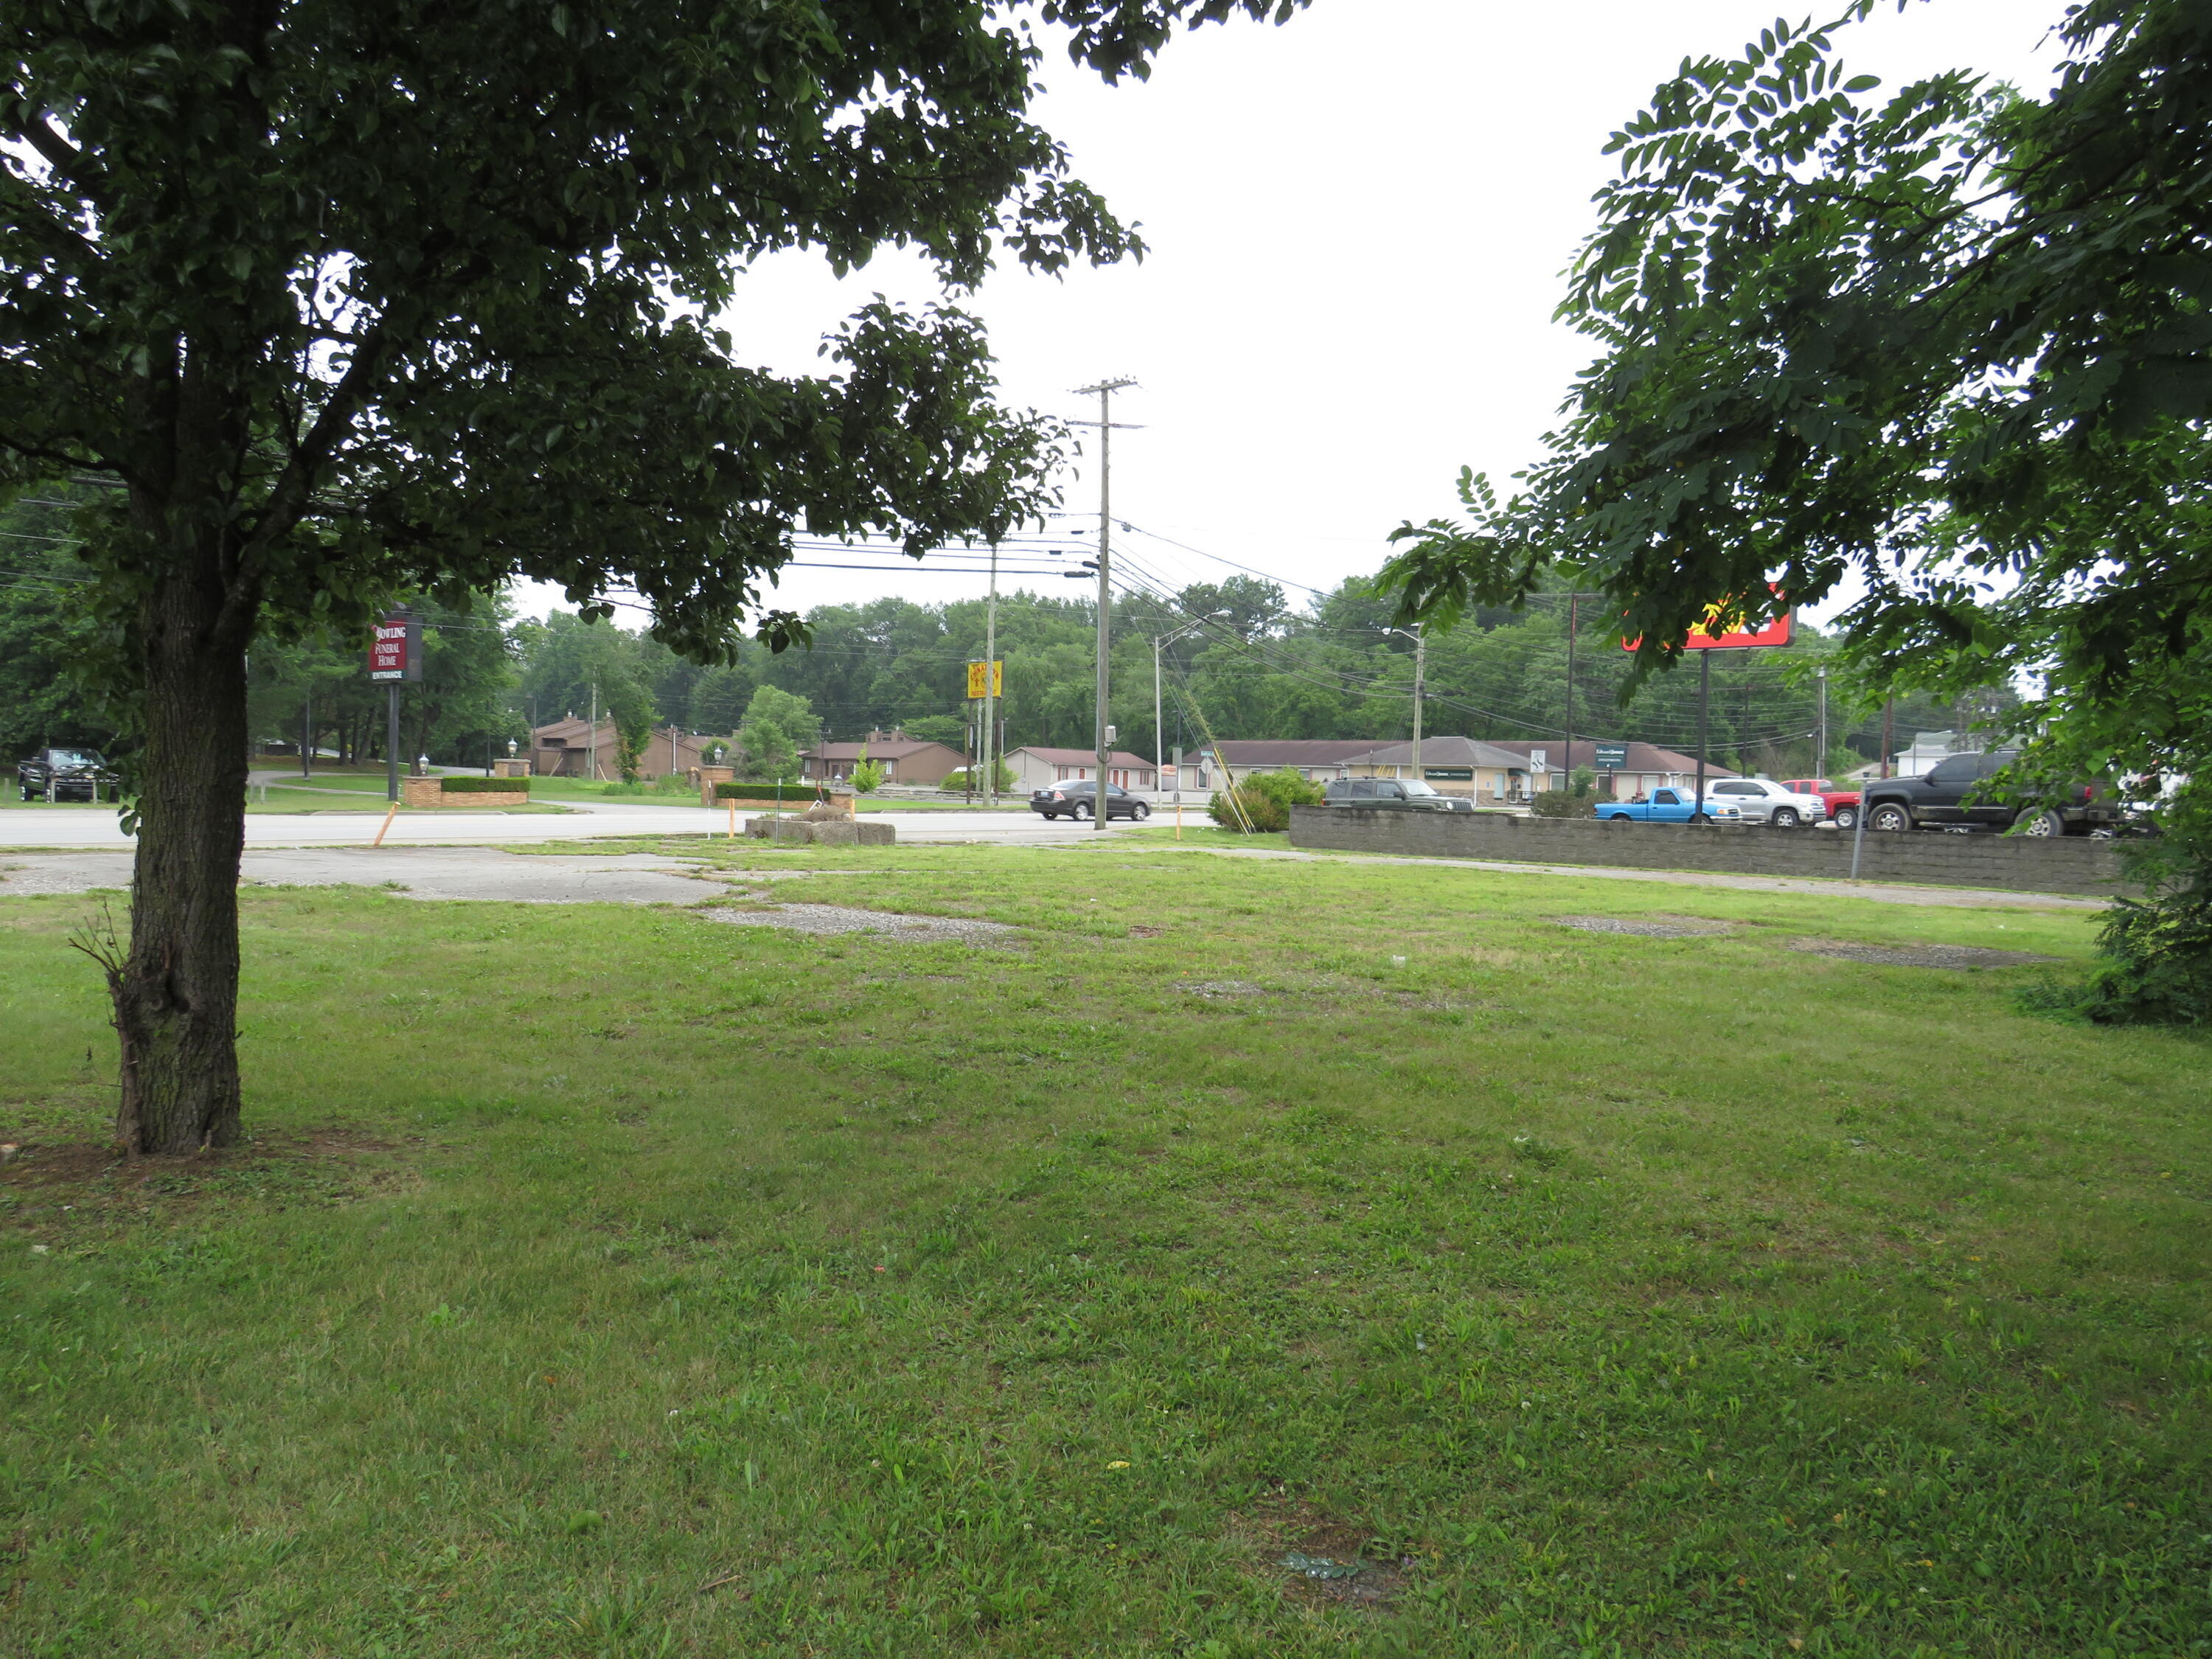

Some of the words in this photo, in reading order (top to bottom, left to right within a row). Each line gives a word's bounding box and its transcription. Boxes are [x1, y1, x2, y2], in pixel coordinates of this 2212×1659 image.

[375, 643, 400, 655] FUNERAL
[378, 655, 397, 667] HOME
[372, 670, 403, 680] ENTRANCE
